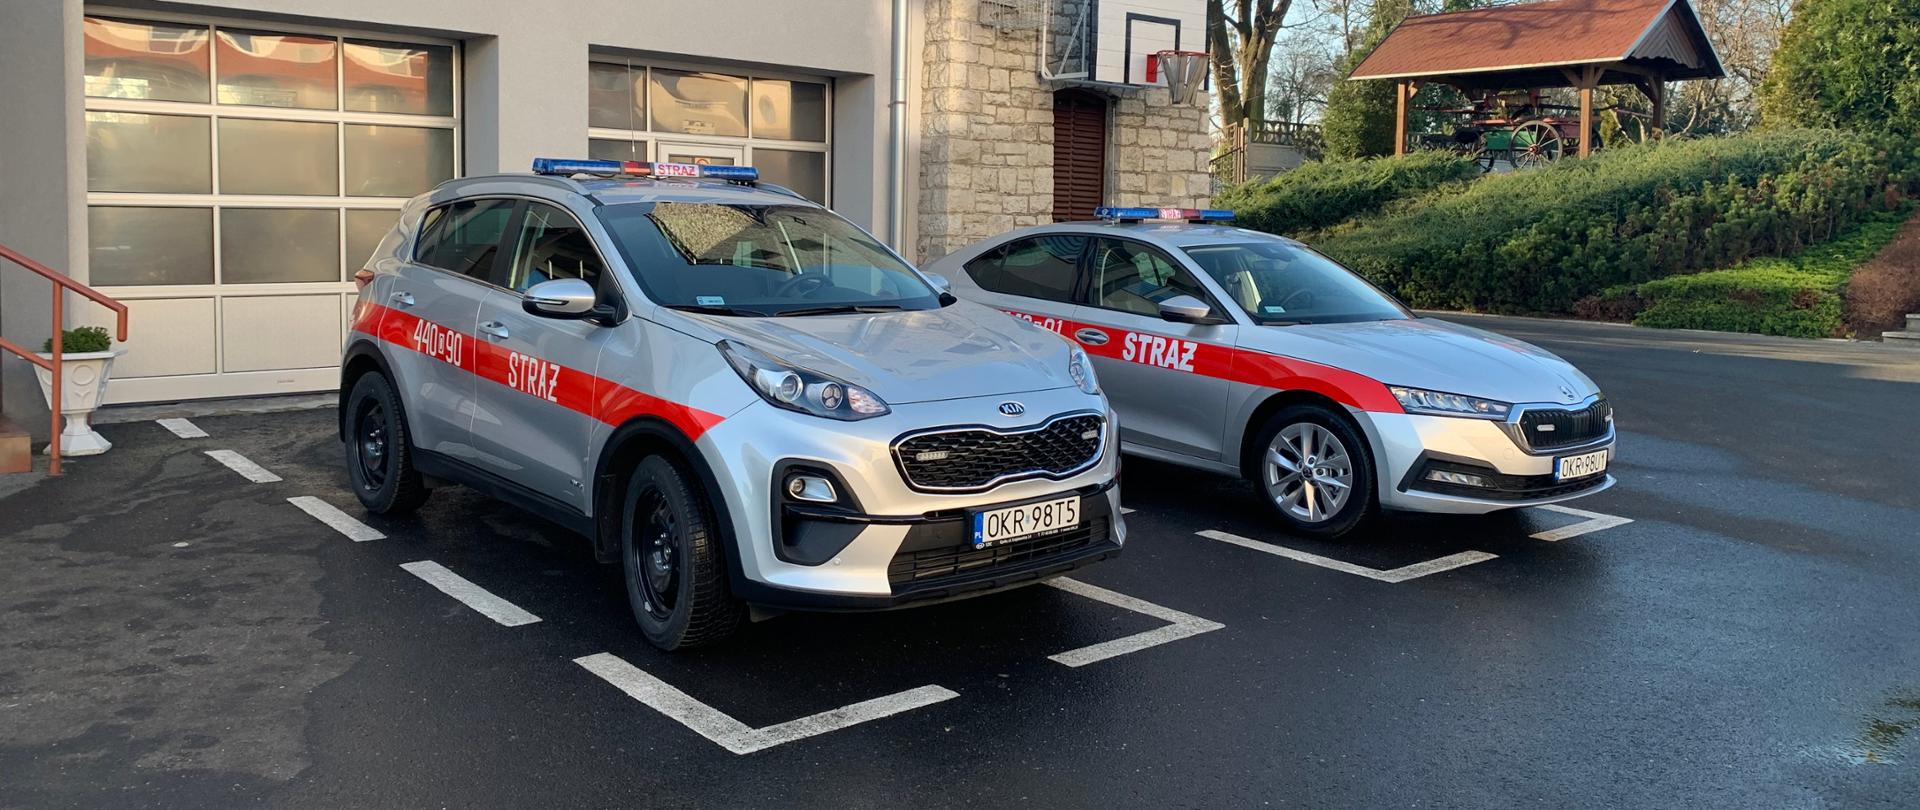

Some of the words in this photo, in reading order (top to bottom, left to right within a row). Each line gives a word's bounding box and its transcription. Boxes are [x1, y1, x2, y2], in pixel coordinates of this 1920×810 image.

[1001, 403, 1024, 414] KIA
[1562, 457, 1582, 477] OKR
[1585, 452, 1605, 473] 98U1
[987, 508, 1025, 538] OKR
[1032, 499, 1076, 531] 98T5
